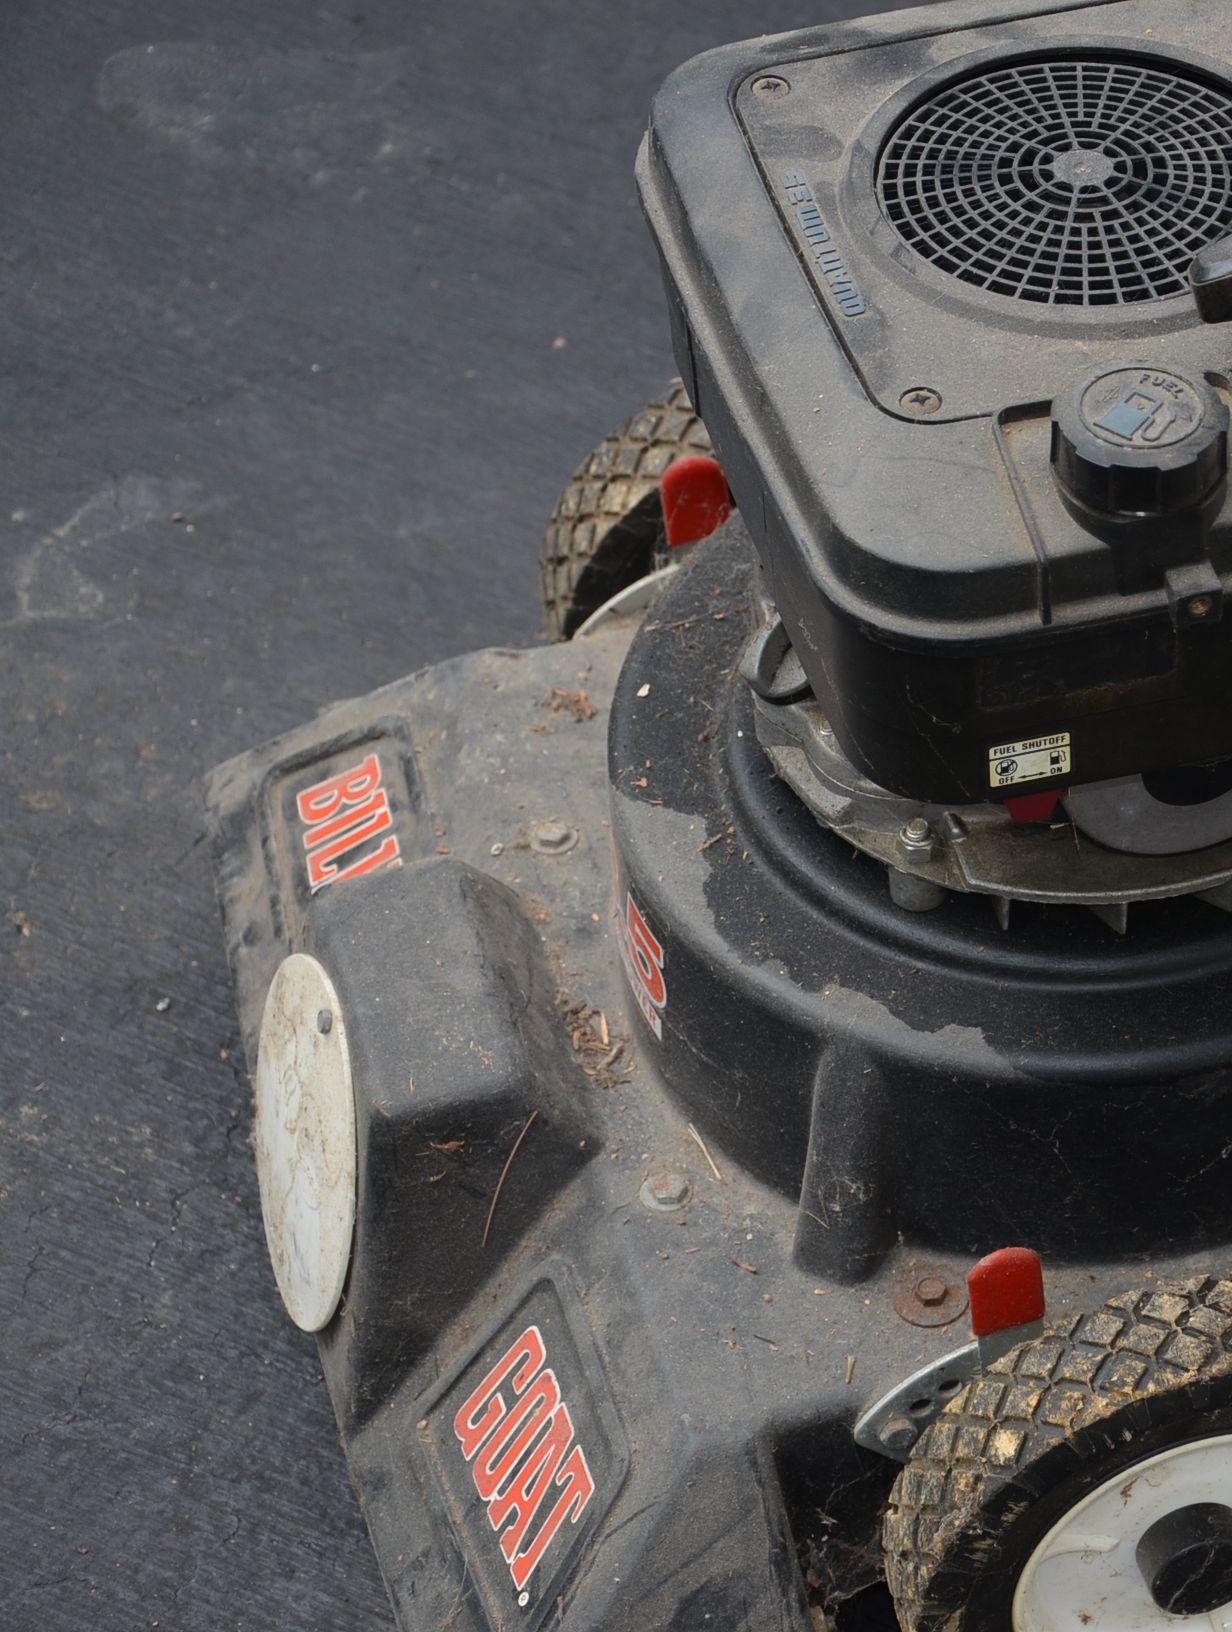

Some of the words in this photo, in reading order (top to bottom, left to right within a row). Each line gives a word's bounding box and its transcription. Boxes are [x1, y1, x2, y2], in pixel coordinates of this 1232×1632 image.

[797, 203, 867, 317] QUANTUM
[1139, 373, 1184, 399] FUEL
[993, 745, 1018, 757] FUEL
[1021, 734, 1067, 751] SHUTOFF
[998, 776, 1016, 785] OFF
[1050, 766, 1063, 775] ON
[454, 1325, 596, 1590] GOAT
